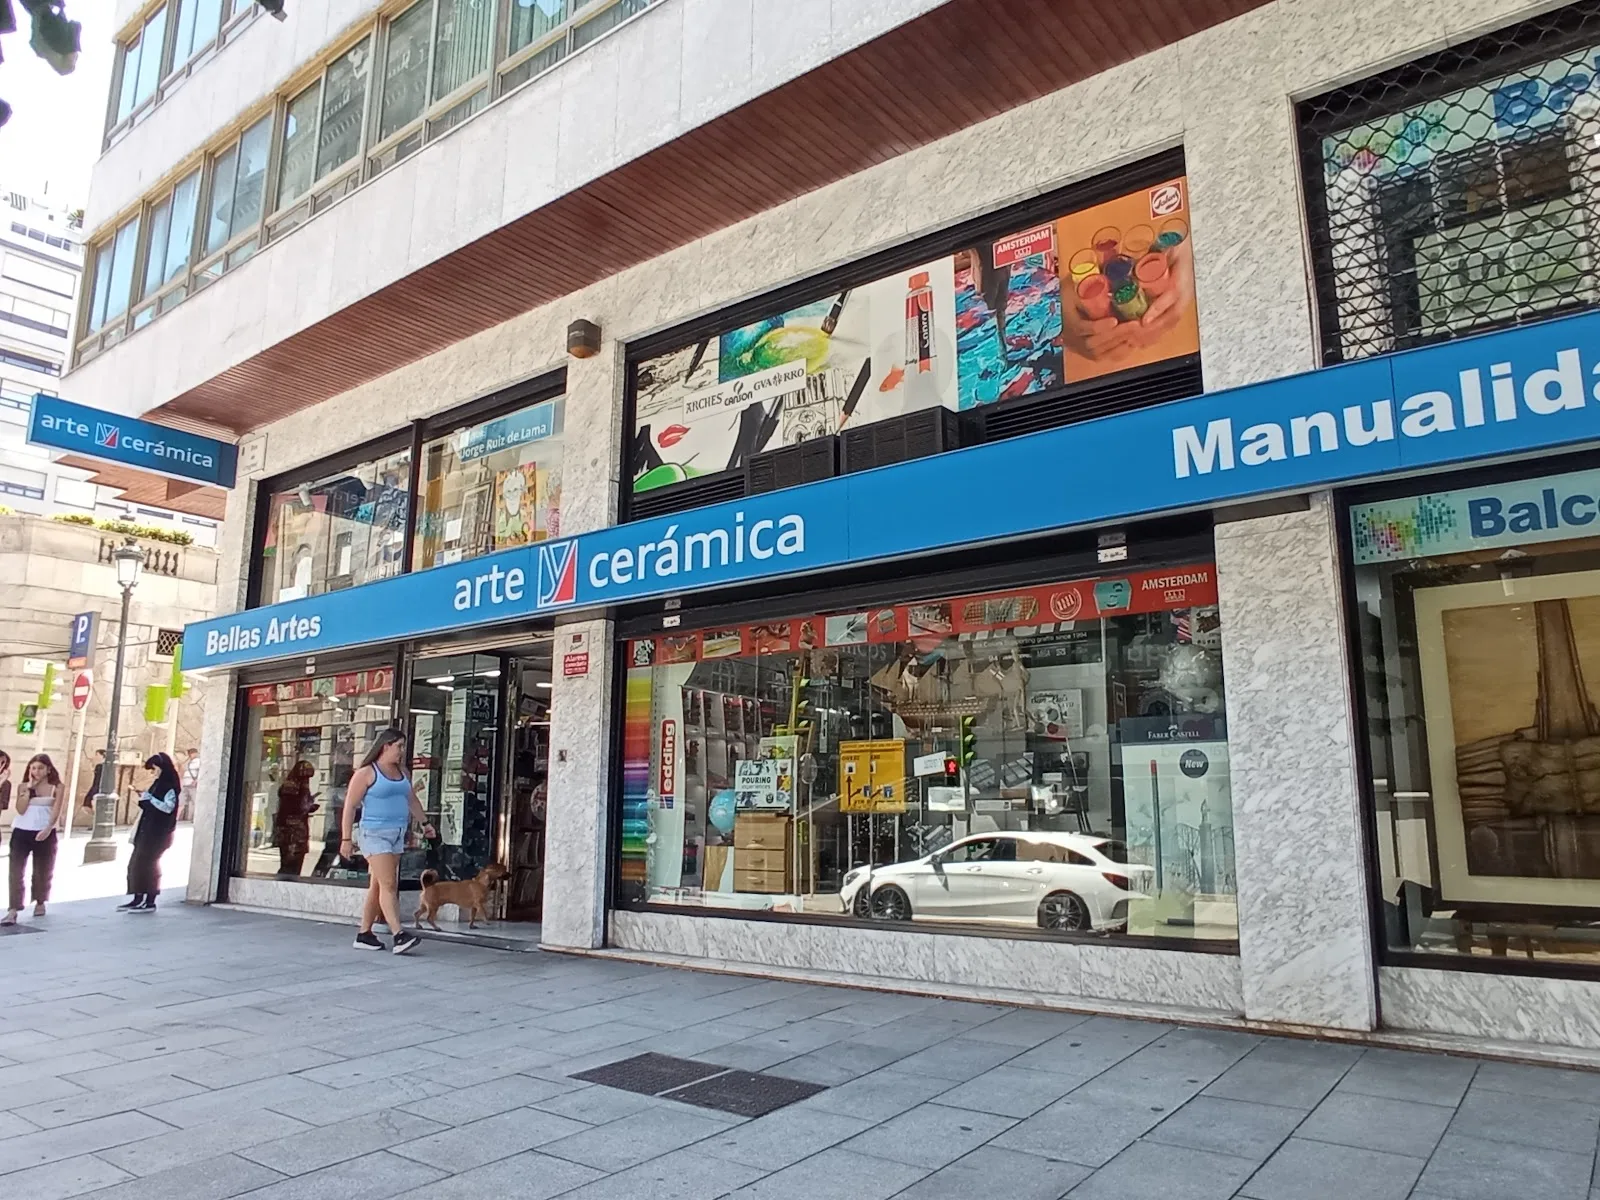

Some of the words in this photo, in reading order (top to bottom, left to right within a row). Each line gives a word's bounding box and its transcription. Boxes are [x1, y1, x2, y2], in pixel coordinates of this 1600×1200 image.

[996, 229, 1050, 254] AMSTERDAM
[685, 391, 724, 414] ARCHES
[1171, 347, 1600, 479] Manualid
[41, 413, 89, 437] arte
[121, 435, 213, 468] cerámica
[460, 443, 485, 458] Jorge
[486, 436, 506, 451] Ruiz
[507, 431, 521, 444] de
[521, 424, 547, 440] Lama
[1468, 488, 1600, 539] Balc
[454, 564, 524, 610] arte
[589, 512, 805, 588] cerámica
[1141, 572, 1208, 590] AMSTERDAM
[206, 625, 261, 656] Bellas
[264, 613, 321, 645] Artes
[663, 723, 675, 792] edding
[1184, 759, 1204, 769] New
[742, 776, 771, 784] POURING
